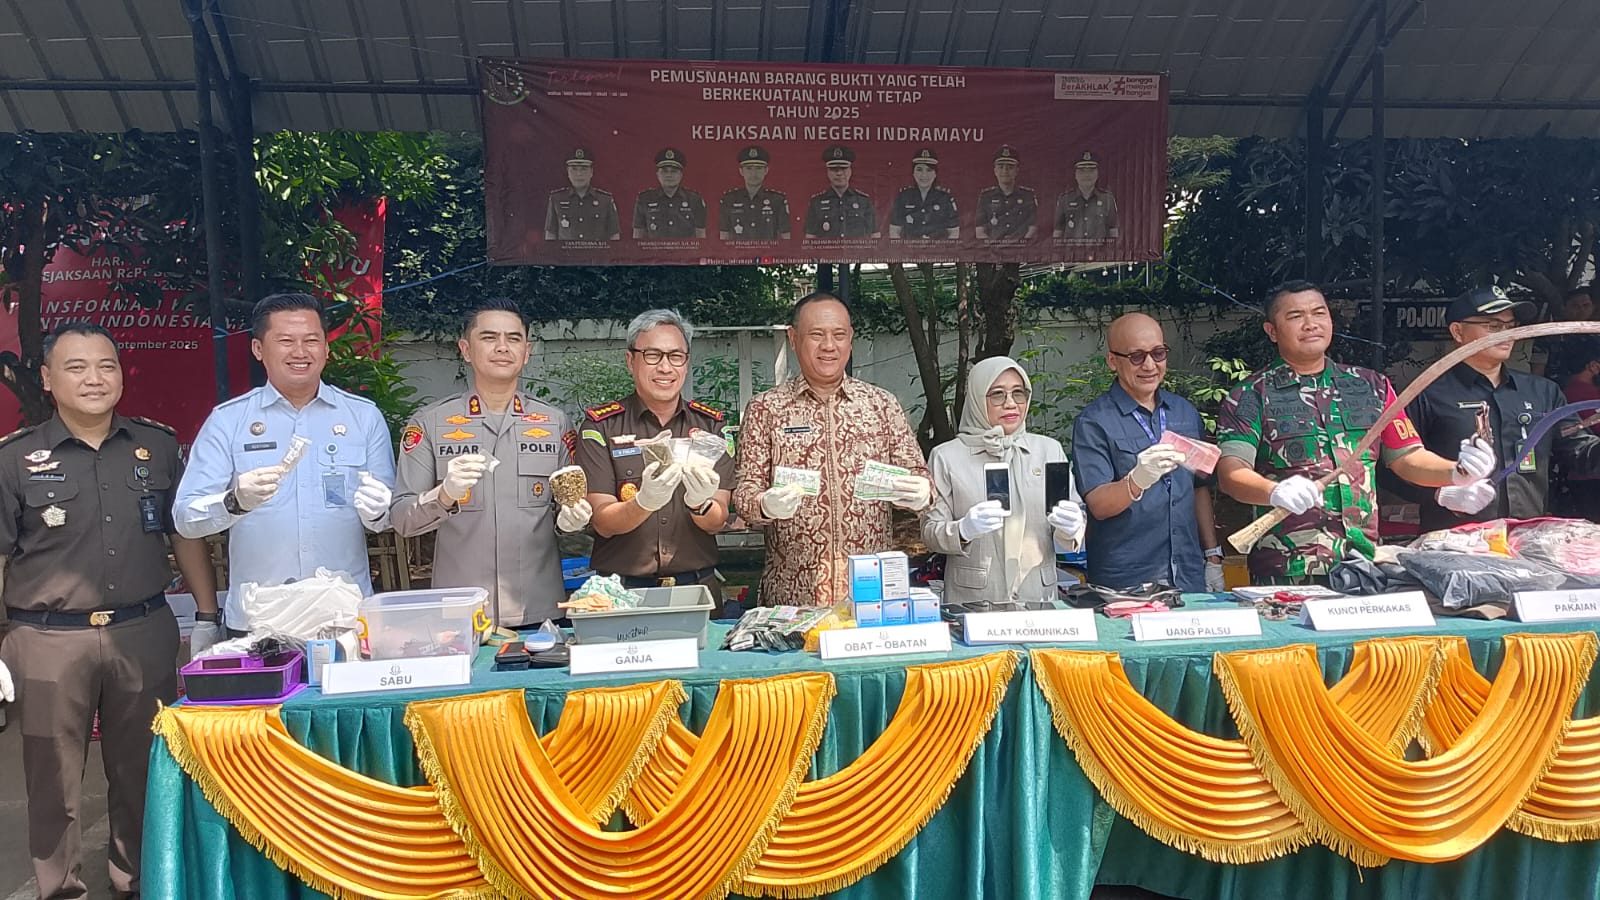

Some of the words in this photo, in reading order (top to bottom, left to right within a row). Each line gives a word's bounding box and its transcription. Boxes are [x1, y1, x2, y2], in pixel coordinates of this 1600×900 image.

[650, 70, 760, 84] PEMUSNAHAN
[765, 72, 826, 85] BARANG
[830, 73, 873, 86] BUKTI
[877, 74, 917, 87] YANG
[920, 75, 965, 88] TELAH
[703, 87, 812, 102] BERKEKUATAN
[817, 89, 872, 103] HUKUM
[876, 91, 922, 103] TETAP
[767, 105, 819, 118] TAHUN
[824, 106, 860, 119] 2025
[692, 125, 796, 140] KEJAKSAAN
[804, 126, 870, 140] NEGERI
[877, 127, 984, 141] INDRAMAYU
[42, 269, 112, 283] EJAKSAAN
[99, 313, 212, 329] INDONESIA
[1397, 306, 1447, 328] POJOK
[117, 340, 167, 352] ptember
[170, 340, 198, 350] 2025
[439, 445, 479, 455] FAJAR
[520, 443, 556, 453] POLRI
[1328, 606, 1358, 615] KUNCI
[1359, 603, 1411, 614] PERKAKAS
[1555, 603, 1597, 612] PAKAIAN
[987, 628, 1012, 636] ALAT
[1015, 627, 1079, 636] KOMUNIKASI
[1166, 628, 1196, 636] UANG
[1198, 627, 1231, 635] PALSU
[844, 641, 873, 652] OBAT
[884, 639, 927, 650] OBATAN
[615, 654, 653, 665] GANJA
[380, 675, 412, 686] SABU
